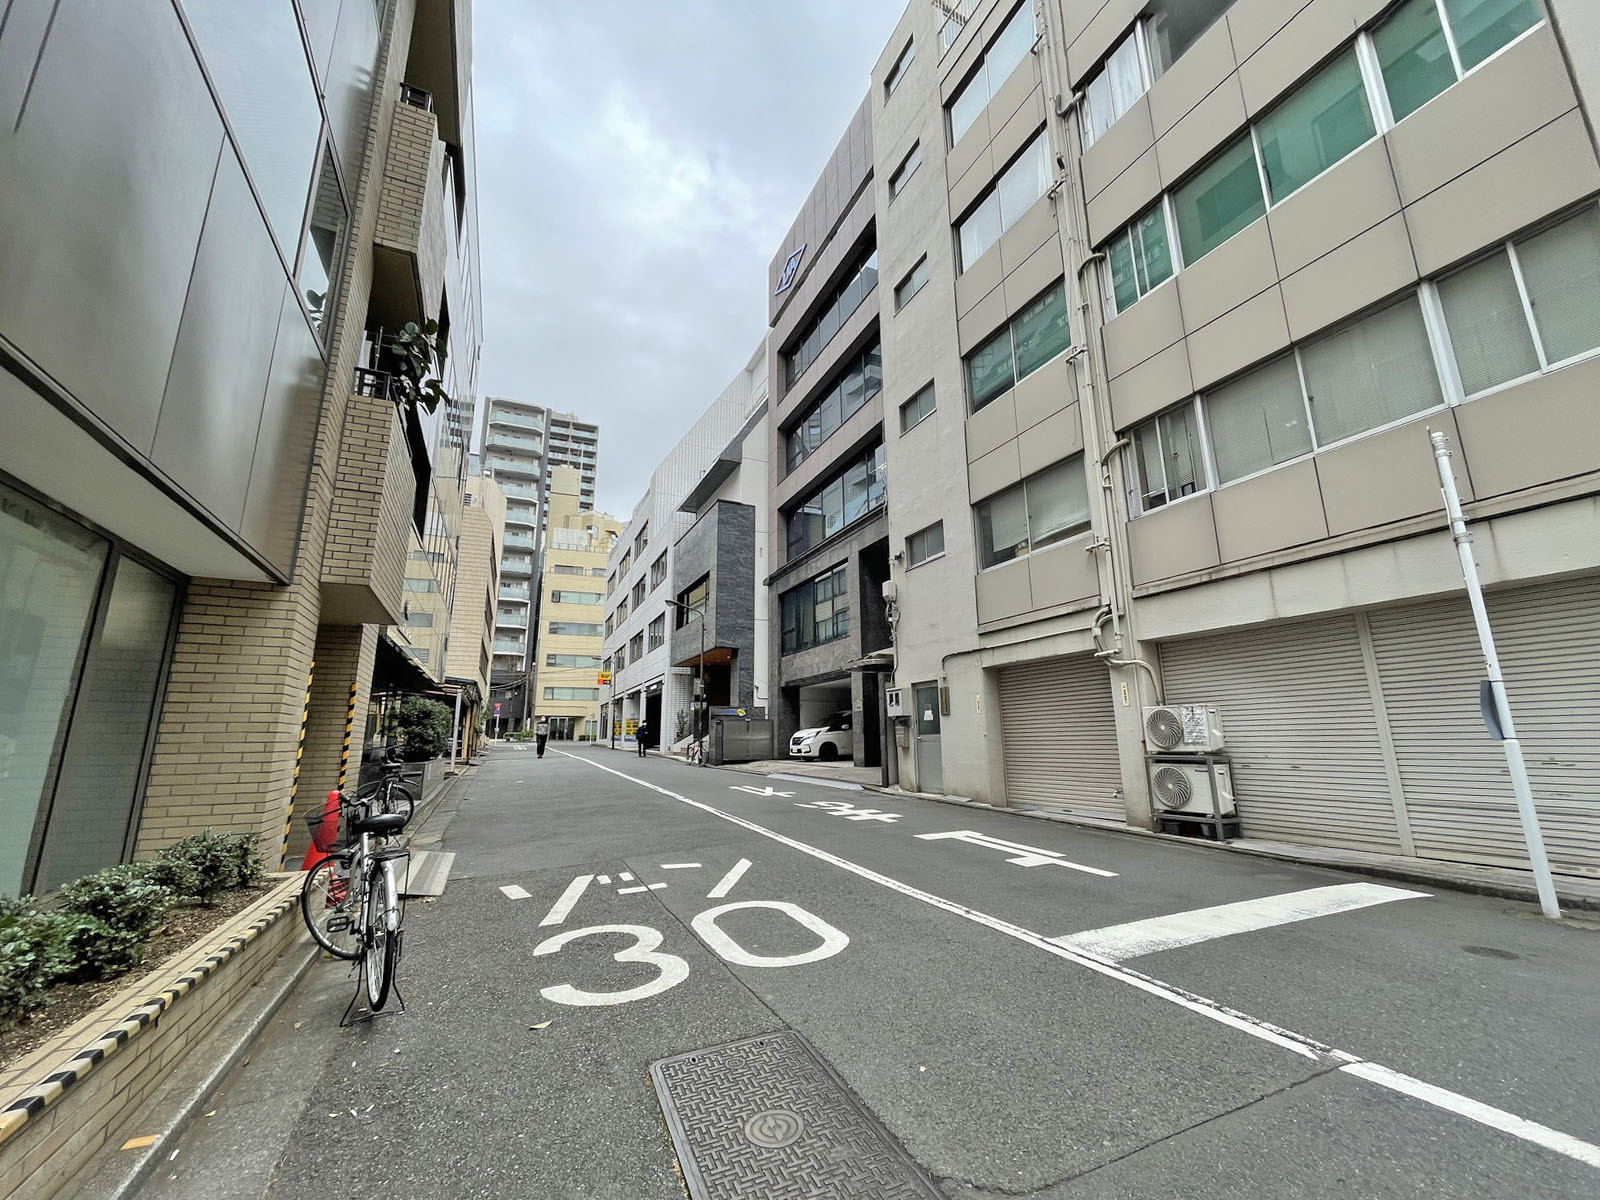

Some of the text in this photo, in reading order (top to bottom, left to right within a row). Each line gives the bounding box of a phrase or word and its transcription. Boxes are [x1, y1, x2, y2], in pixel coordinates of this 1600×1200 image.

[498, 858, 752, 927] ゾーン
[533, 900, 850, 1006] 30
